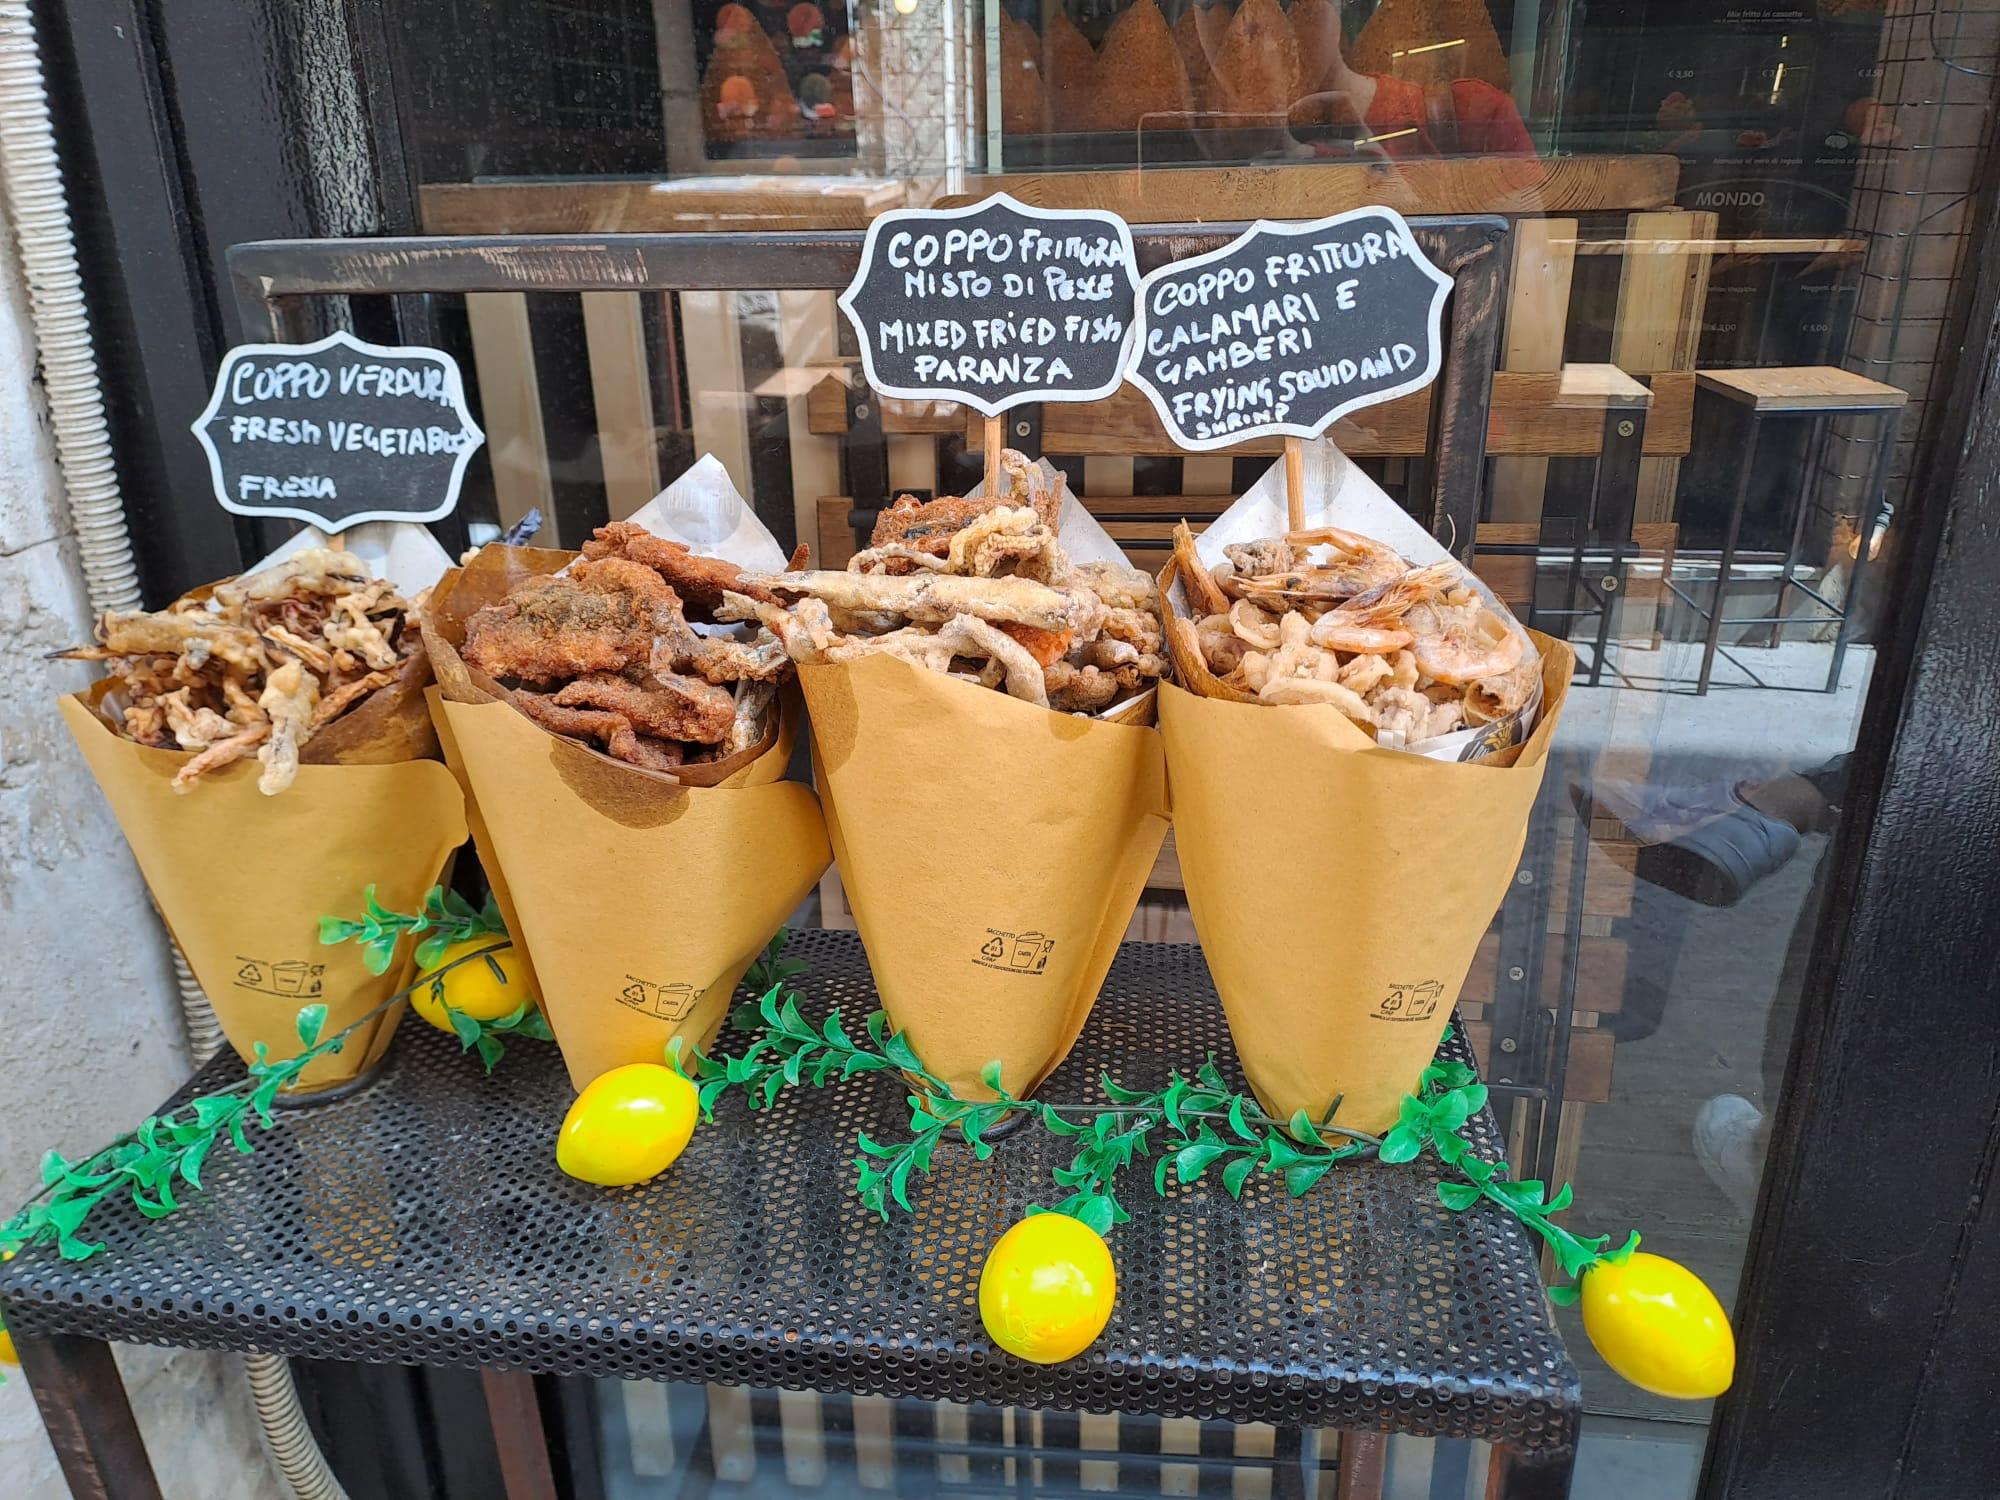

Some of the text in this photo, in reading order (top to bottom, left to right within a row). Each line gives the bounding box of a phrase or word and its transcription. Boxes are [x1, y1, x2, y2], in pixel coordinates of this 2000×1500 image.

[1695, 191, 1765, 207] MONDO
[888, 228, 1013, 268] COPPO
[904, 269, 992, 299] MISTO
[1003, 272, 1034, 298] DI
[1153, 230, 1409, 316] COPPO FRITTURA
[879, 319, 967, 354] MIXED
[1147, 279, 1360, 357] CALAMARI E
[914, 353, 1073, 385] PARANZA
[1155, 327, 1313, 386] GAMBERI
[232, 361, 332, 405] COPPO
